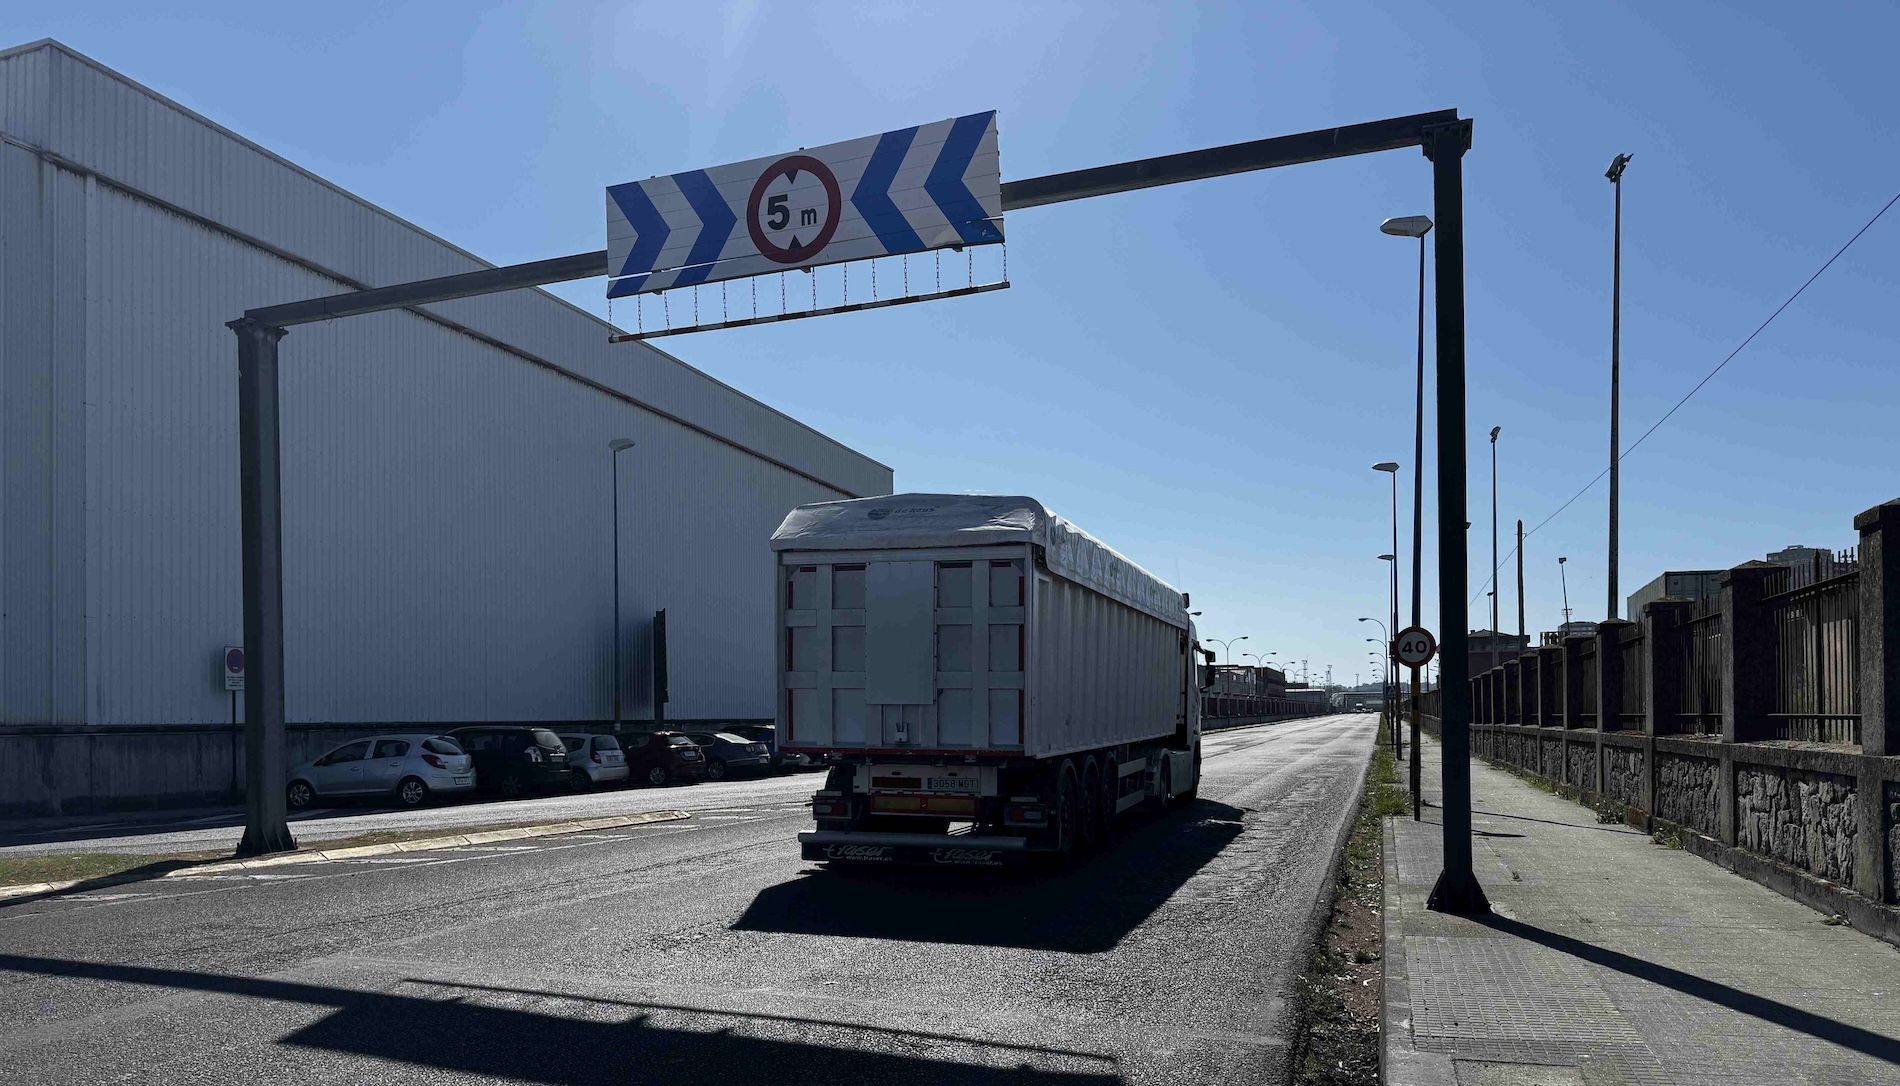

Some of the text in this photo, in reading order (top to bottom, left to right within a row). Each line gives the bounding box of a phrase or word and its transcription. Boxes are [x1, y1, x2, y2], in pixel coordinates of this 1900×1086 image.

[767, 193, 817, 231] 5 m
[1402, 640, 1427, 654] 40
[933, 779, 956, 788] 3058
